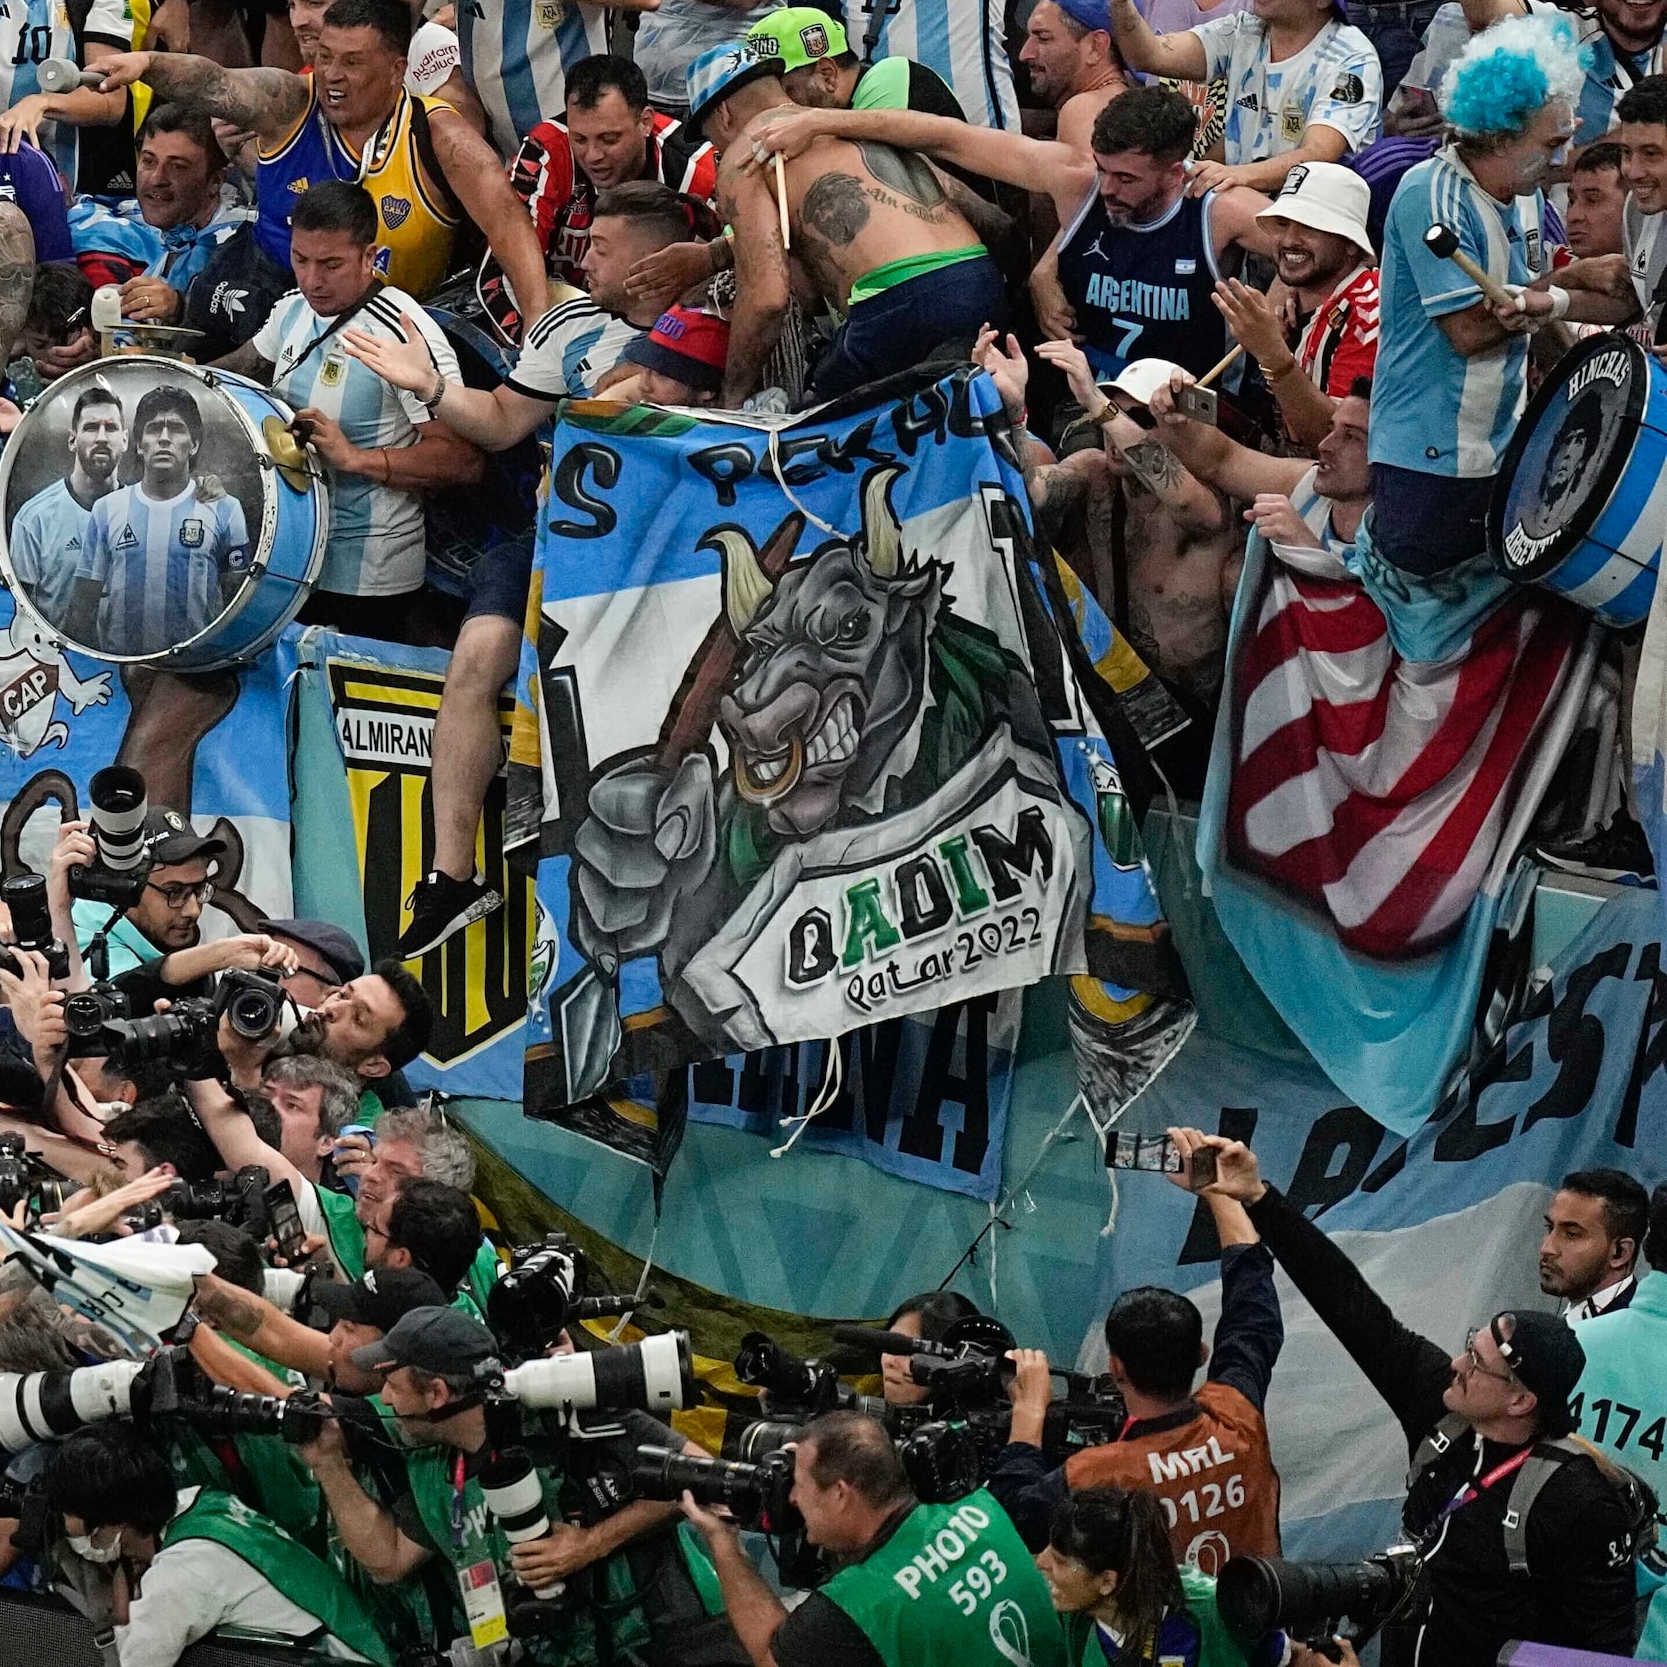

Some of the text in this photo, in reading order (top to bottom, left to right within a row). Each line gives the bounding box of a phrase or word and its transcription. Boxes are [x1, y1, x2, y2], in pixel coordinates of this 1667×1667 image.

[422, 55, 456, 82] Salud
[209, 280, 229, 315] adidas
[1085, 272, 1191, 321] ARGENTINA
[1111, 318, 1144, 360] 7
[551, 441, 621, 537] S
[1, 668, 49, 720] CAP
[342, 717, 435, 757] ALMIRAN
[786, 805, 1055, 987] QADIM
[894, 1504, 992, 1600] PHOTO
[947, 1553, 1009, 1616] 593
